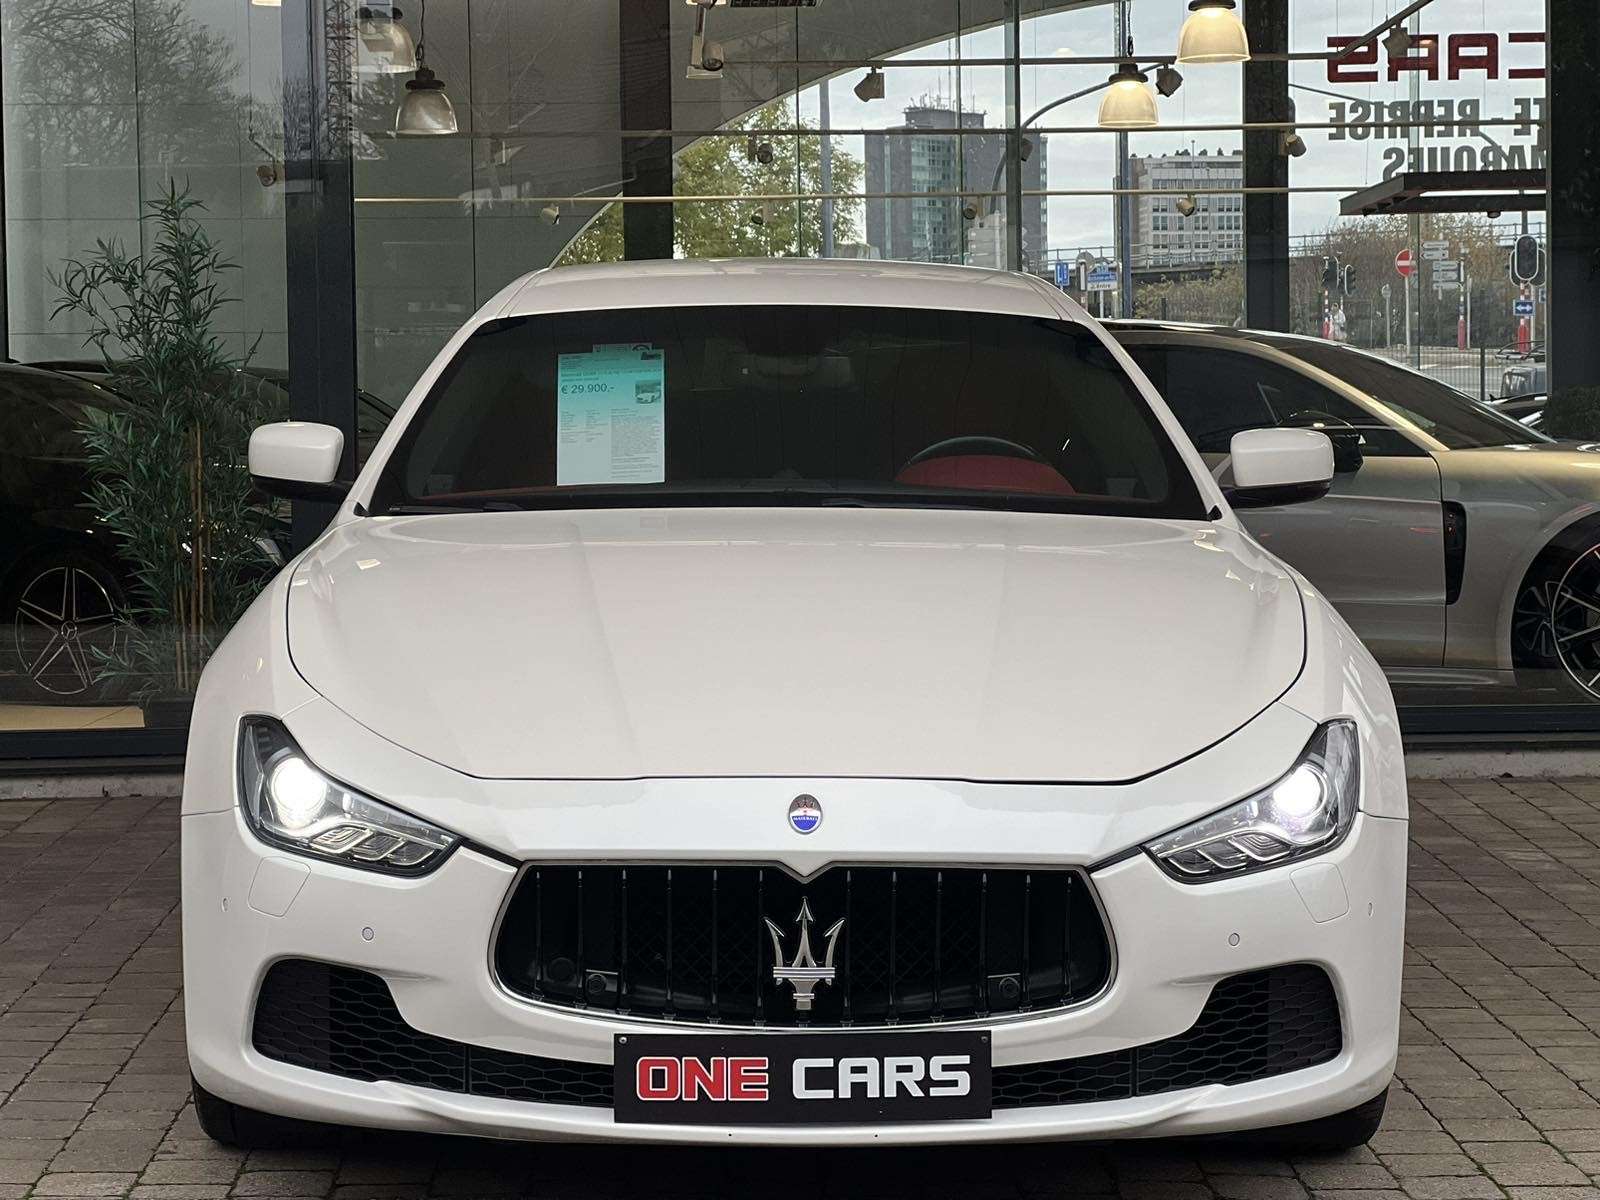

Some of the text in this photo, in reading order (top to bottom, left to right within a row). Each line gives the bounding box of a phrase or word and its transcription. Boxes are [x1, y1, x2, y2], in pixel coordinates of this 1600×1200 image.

[561, 384, 569, 394] €
[636, 1054, 971, 1101] ONE CARS
